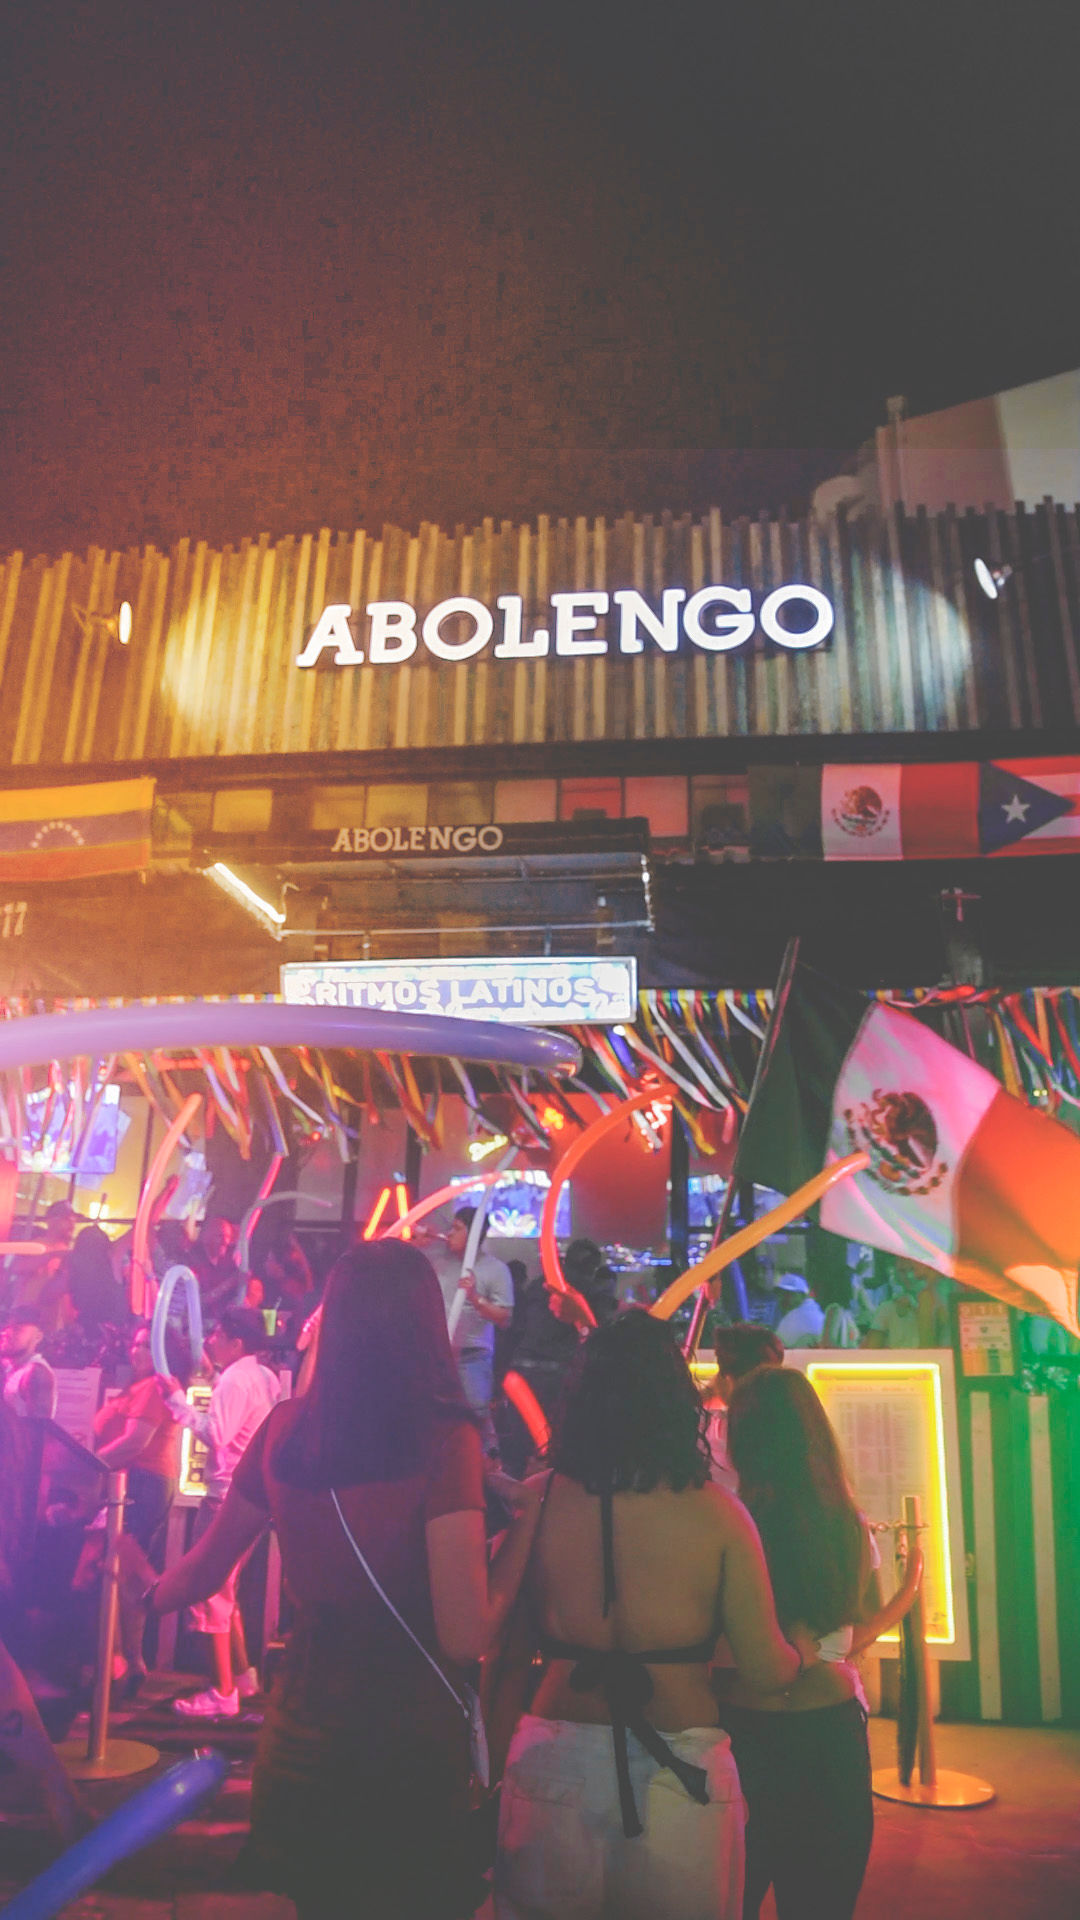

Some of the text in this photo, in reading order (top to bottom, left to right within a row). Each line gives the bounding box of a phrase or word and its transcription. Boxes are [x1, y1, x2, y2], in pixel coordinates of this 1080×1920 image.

[296, 584, 834, 668] ABOLENGO
[331, 825, 504, 853] ABOLENGO
[315, 977, 597, 1006] RITMOS LATINOS
